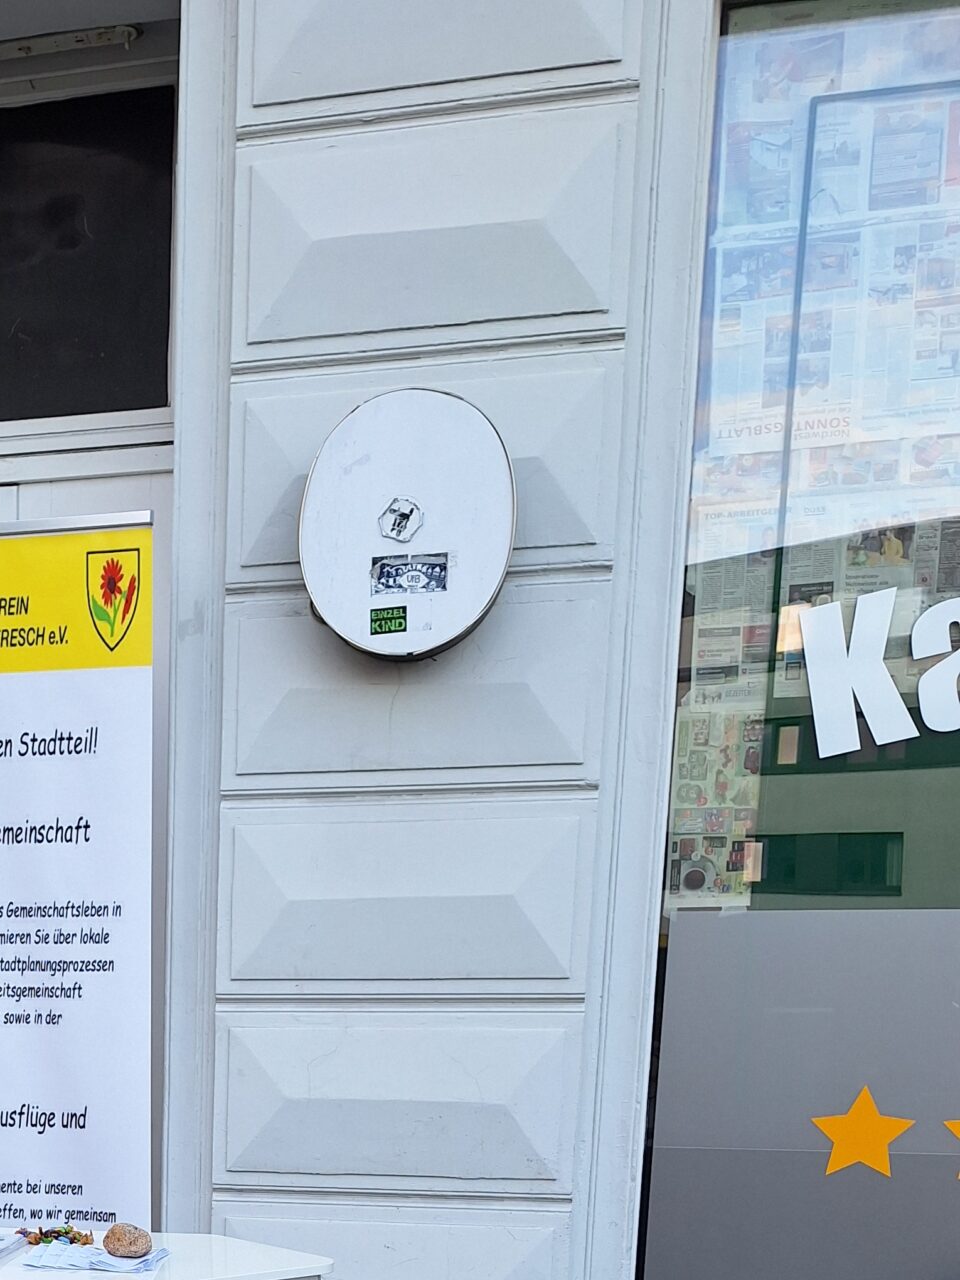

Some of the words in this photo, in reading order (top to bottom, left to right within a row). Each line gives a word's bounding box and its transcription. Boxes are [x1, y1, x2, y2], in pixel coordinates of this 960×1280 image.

[716, 416, 850, 440] SONNTGSBLATT
[371, 608, 406, 619] EINZEL
[371, 618, 406, 633] KIND
[49, 626, 68, 645] e.V.
[18, 727, 97, 756] Stadtteil!
[6, 901, 108, 918] Gemeinschaftsleben
[112, 902, 121, 917] in
[34, 929, 49, 944] Sie
[53, 929, 77, 944] über
[80, 928, 109, 944] lokale
[4, 1011, 30, 1024] sowie
[34, 1011, 42, 1024] in
[45, 1009, 62, 1025] der
[62, 1106, 87, 1129] und
[26, 1180, 41, 1194] bei
[45, 1184, 82, 1195] unseren
[30, 1209, 42, 1219] wo
[46, 1209, 62, 1220] wir
[64, 1208, 116, 1224] gemeinsam
